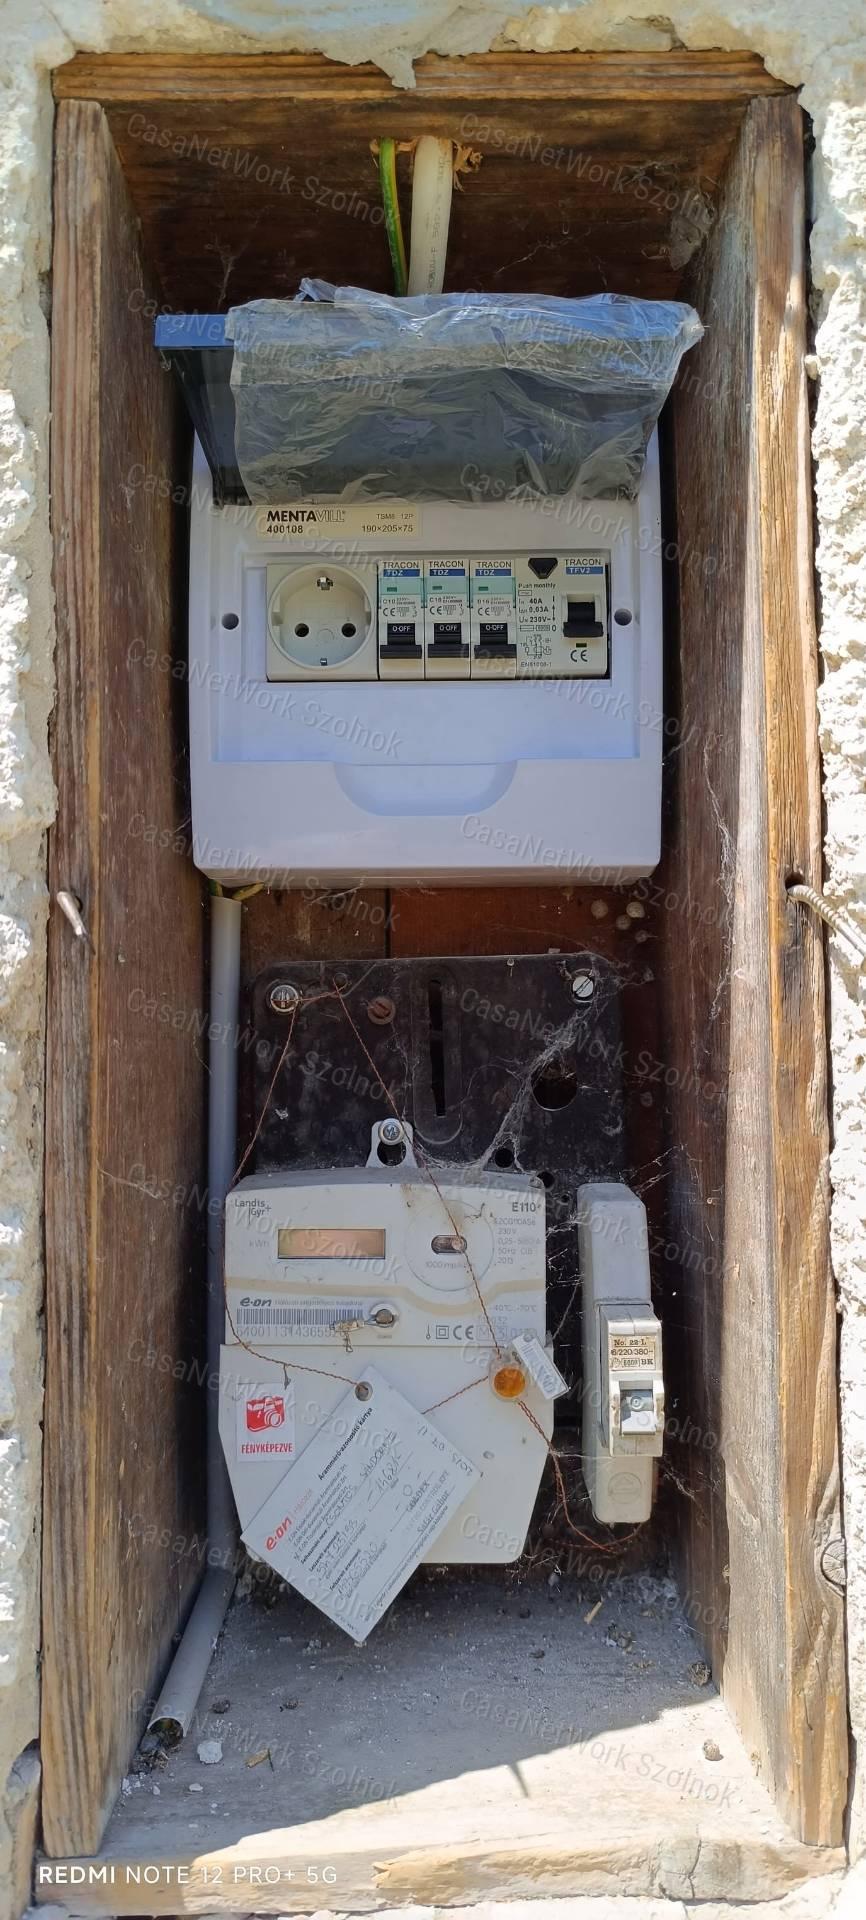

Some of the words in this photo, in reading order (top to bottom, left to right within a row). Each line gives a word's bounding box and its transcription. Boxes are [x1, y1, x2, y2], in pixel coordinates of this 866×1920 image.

[267, 510, 343, 522] MENTAVILL
[267, 525, 303, 533] 400108
[383, 561, 419, 569] TRACON
[429, 560, 464, 568] TRACON
[235, 1198, 265, 1208] Landis
[512, 1202, 536, 1213] E110
[241, 1441, 293, 1454] FÉNYKÉPEZVE
